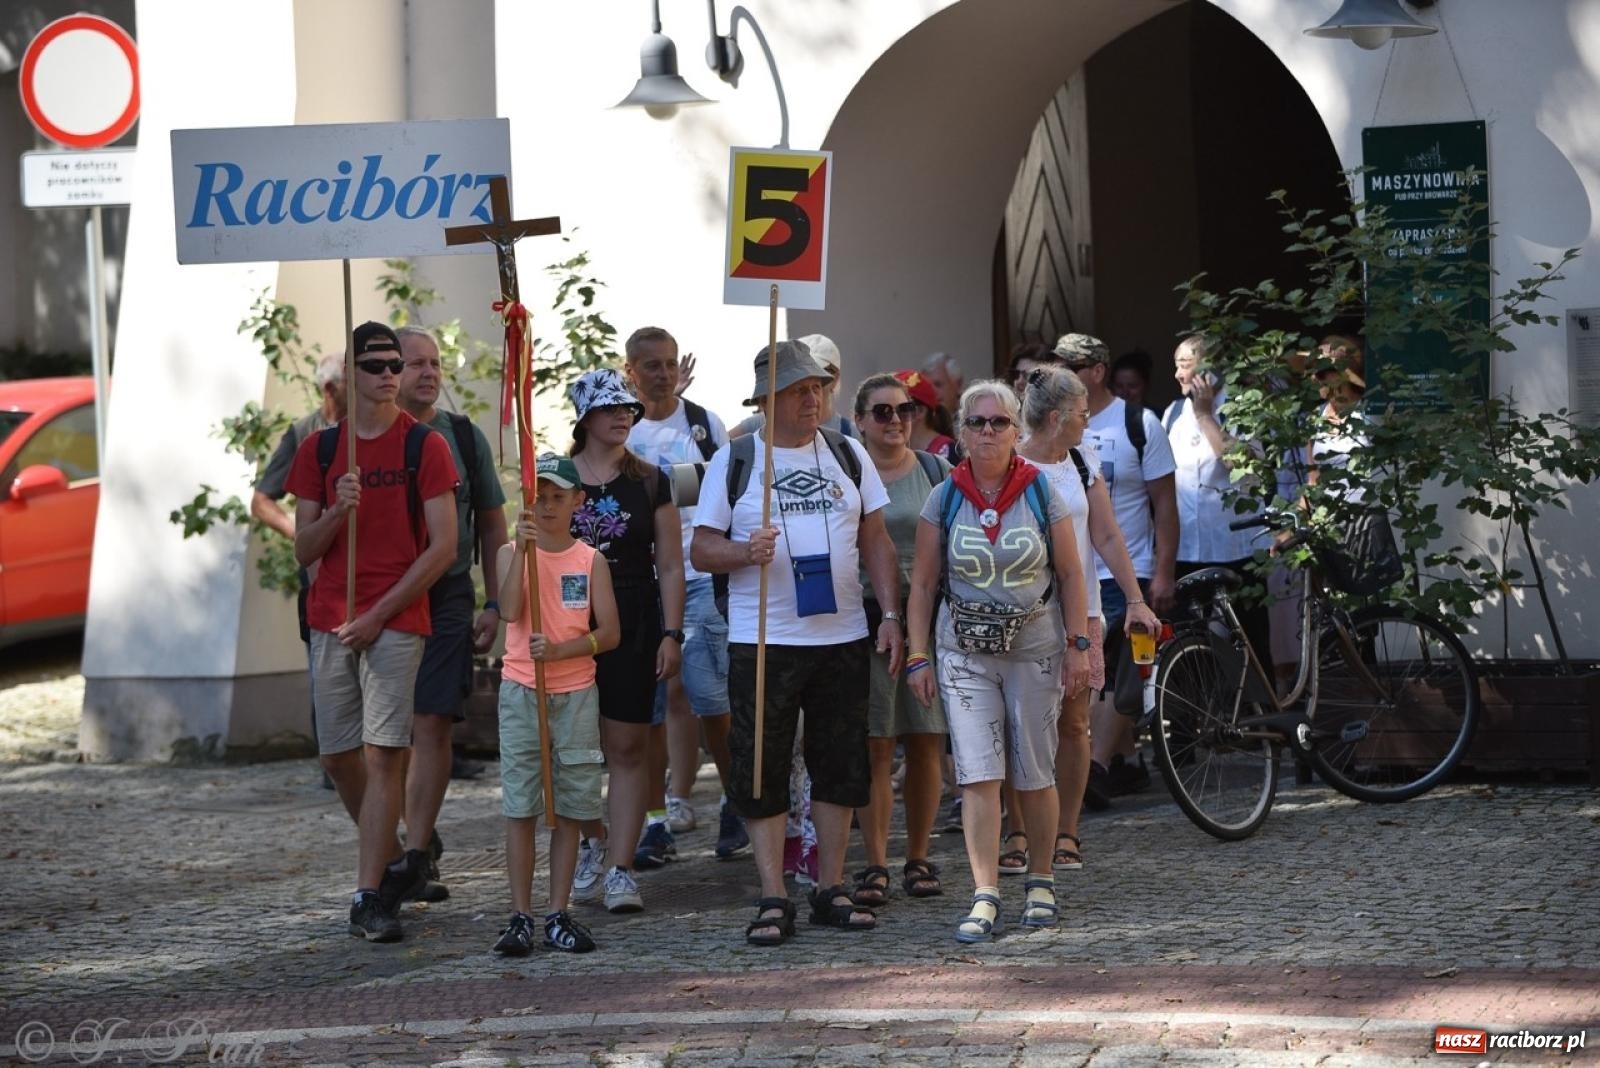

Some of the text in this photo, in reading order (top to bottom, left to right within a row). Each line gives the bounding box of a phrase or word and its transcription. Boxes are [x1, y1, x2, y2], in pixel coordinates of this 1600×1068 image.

[186, 154, 504, 228] Racibórz
[743, 165, 811, 266] 5
[780, 499, 833, 512] umbro
[953, 524, 1043, 588] 52
